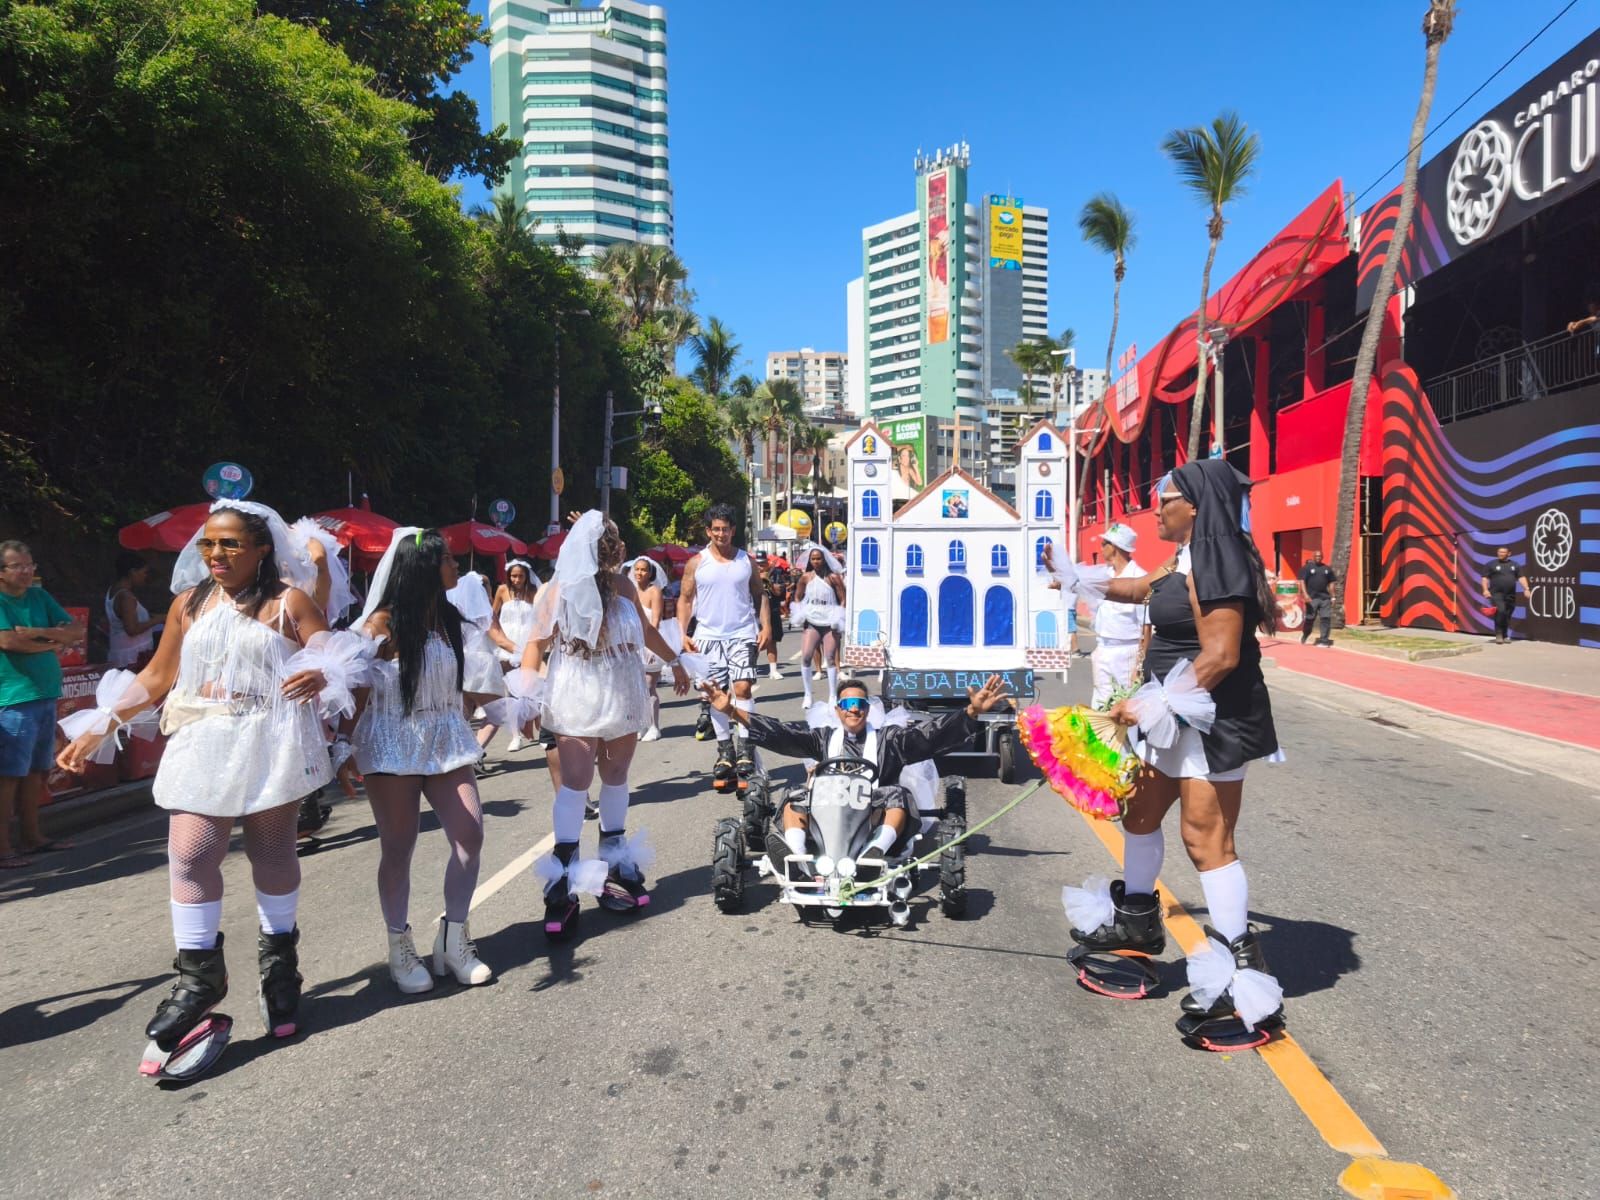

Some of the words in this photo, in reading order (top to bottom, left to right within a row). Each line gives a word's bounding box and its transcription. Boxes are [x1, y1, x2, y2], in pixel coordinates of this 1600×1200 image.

[1529, 576, 1576, 584] CAMAROTE
[1530, 585, 1576, 619] CLUB
[924, 672, 951, 689] DA
